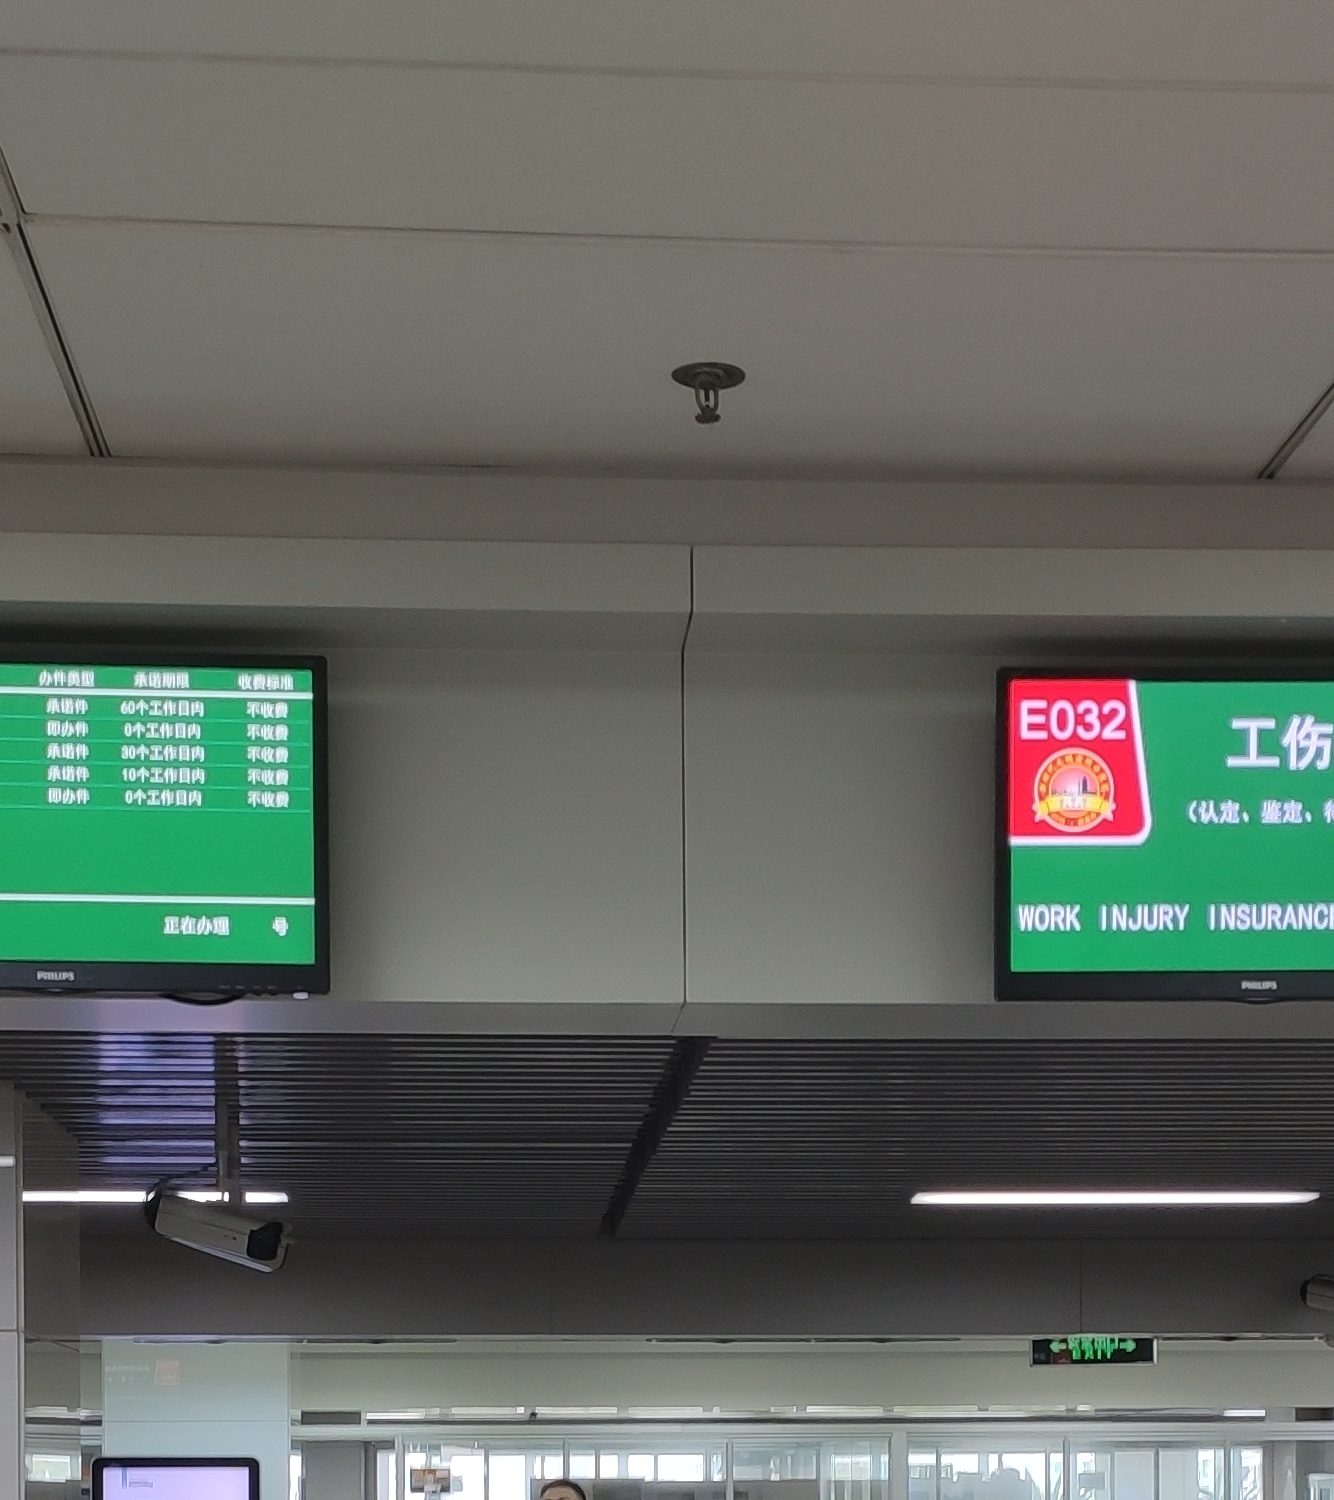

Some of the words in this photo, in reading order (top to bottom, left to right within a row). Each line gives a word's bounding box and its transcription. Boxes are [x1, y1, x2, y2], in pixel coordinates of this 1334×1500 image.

[120, 700, 204, 718] 60个工作日内
[1019, 699, 1126, 741] E032
[124, 723, 201, 741] 0个工作日内
[122, 767, 205, 785] 10个工作日内
[124, 789, 202, 807] 0个工作日内
[163, 916, 229, 936] 正在办理
[1018, 903, 1081, 932] WORK
[1099, 903, 1190, 932] INJURY
